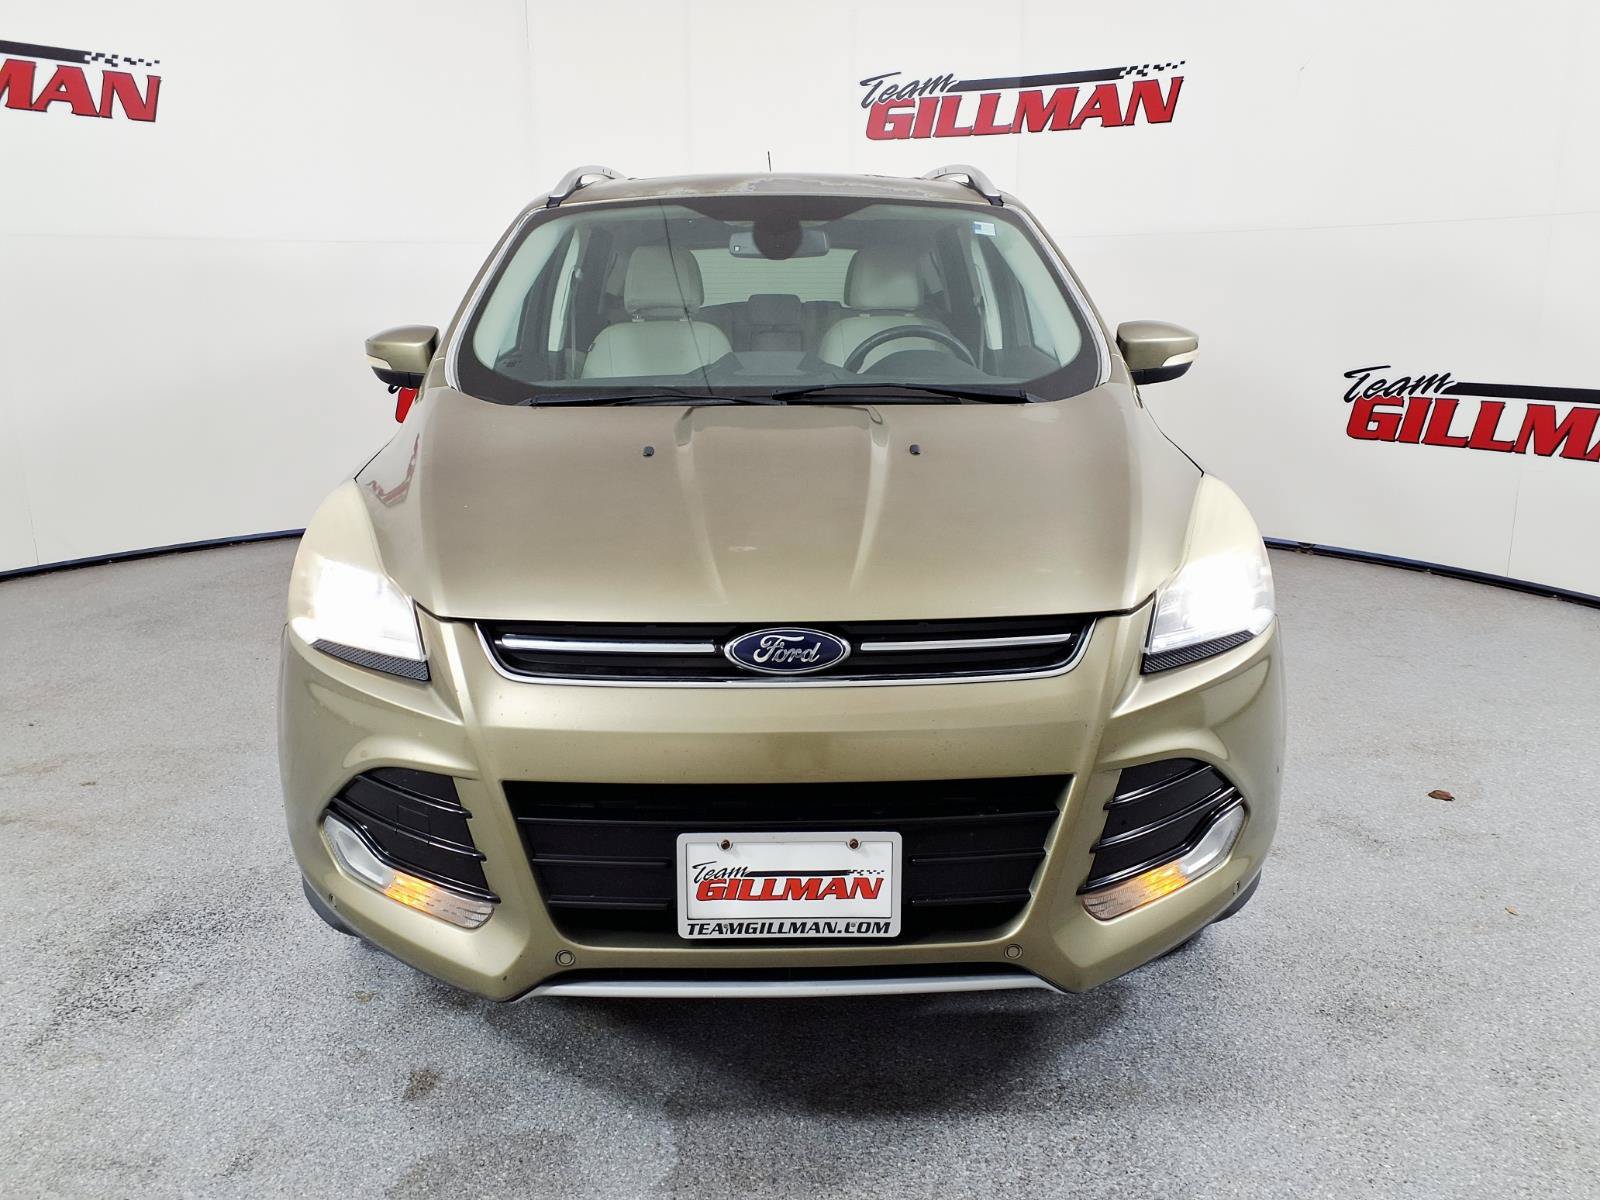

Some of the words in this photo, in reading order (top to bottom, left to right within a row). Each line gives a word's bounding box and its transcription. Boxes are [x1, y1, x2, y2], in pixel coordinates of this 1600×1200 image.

[860, 71, 955, 109] Team
[866, 76, 1184, 140] GILLMAN
[1344, 365, 1454, 403] Team
[1346, 395, 1600, 462] GILLM
[753, 634, 821, 663] Ford
[692, 860, 748, 884] Team
[695, 877, 884, 901] GILLMAN
[687, 921, 891, 936] TEAMGILLMAN.COM
